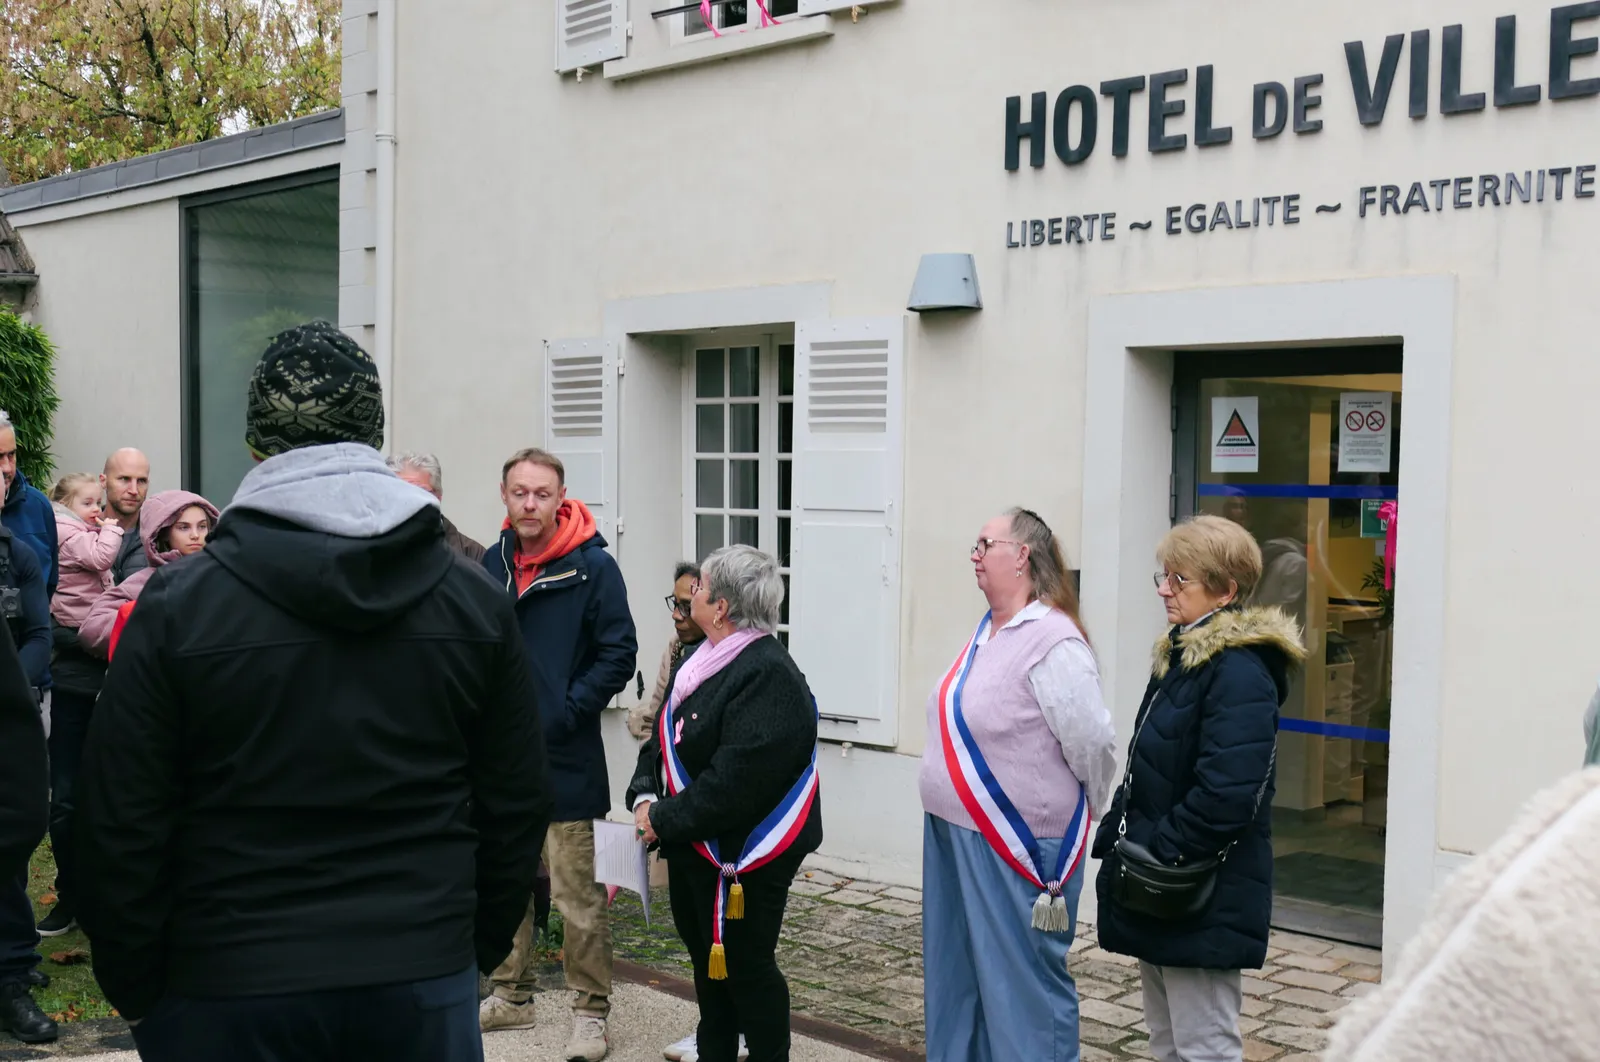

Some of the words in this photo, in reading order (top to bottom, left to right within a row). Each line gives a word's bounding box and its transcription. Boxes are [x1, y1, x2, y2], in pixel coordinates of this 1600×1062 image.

[1004, 64, 1233, 171] HOTEL
[1252, 73, 1324, 140] DE
[1343, 1, 1600, 126] VILLE
[1006, 212, 1117, 249] LIBERTE
[1165, 193, 1301, 236] EGALITE
[1358, 164, 1597, 218] FRATERNITE
